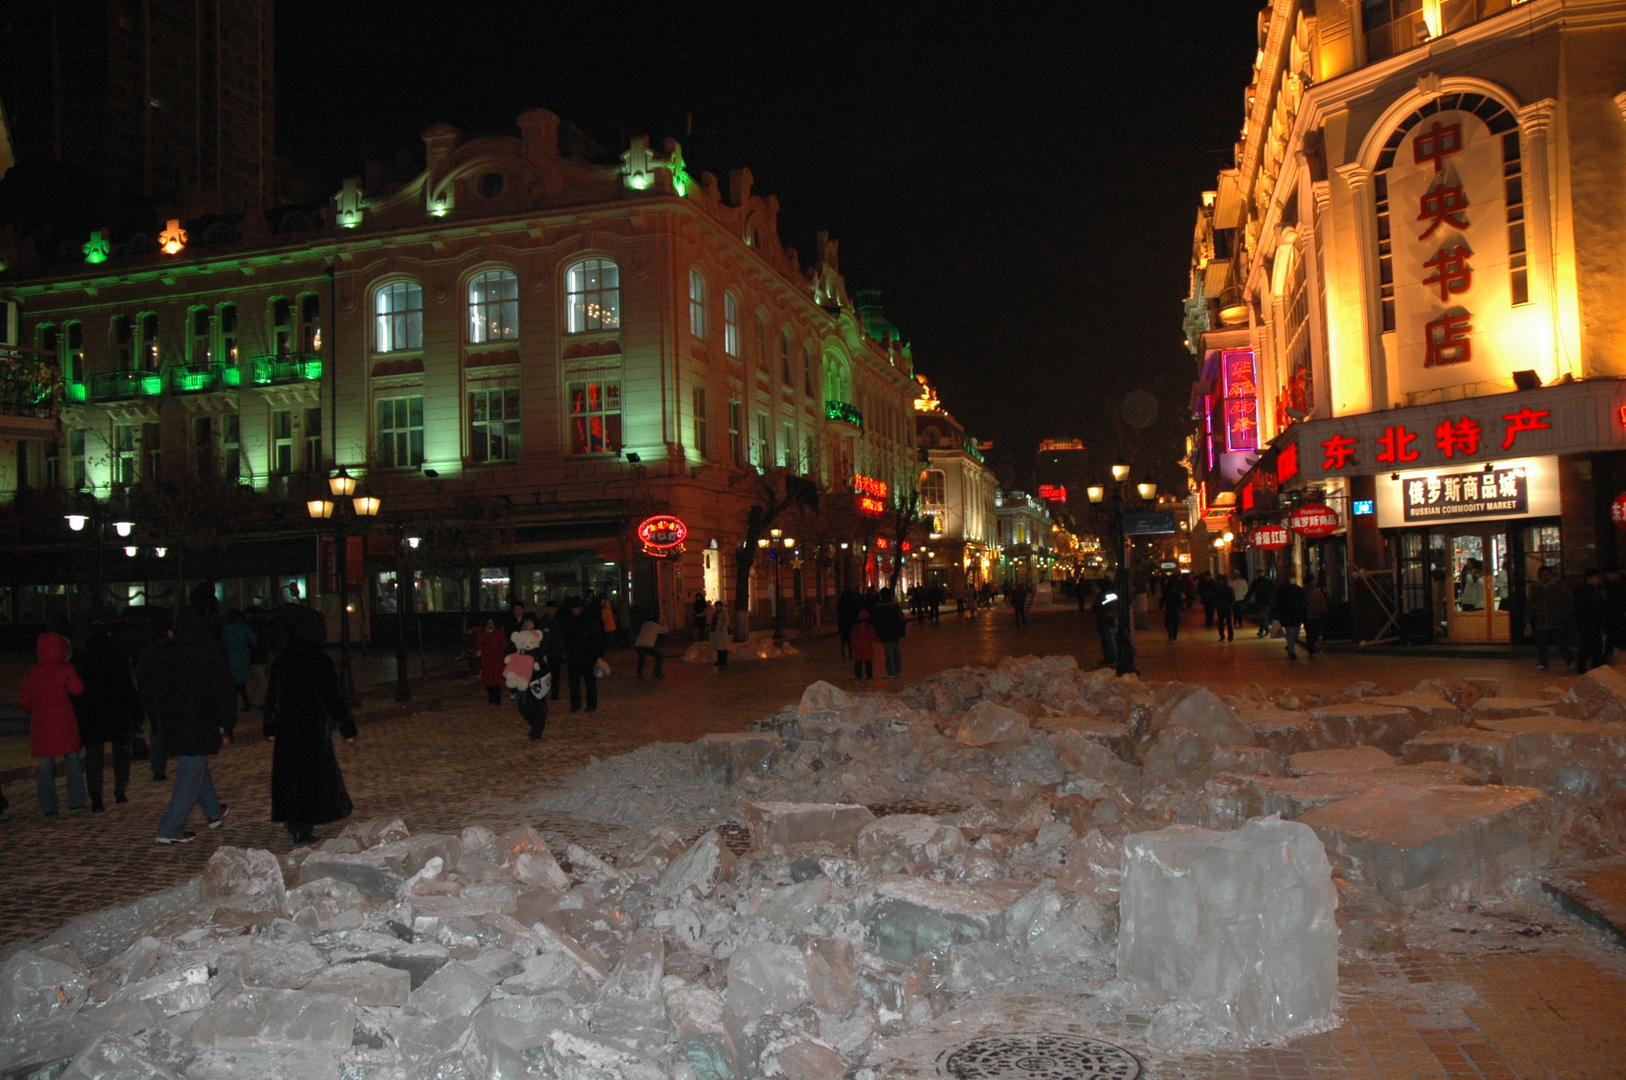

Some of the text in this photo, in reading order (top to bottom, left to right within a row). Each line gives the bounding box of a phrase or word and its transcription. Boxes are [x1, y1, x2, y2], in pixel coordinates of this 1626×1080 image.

[1413, 121, 1474, 368] 中央书店
[1321, 407, 1550, 470] 东北特产
[1409, 471, 1517, 505] 俄罗斯商品城
[1410, 500, 1517, 516] RUSSIAN COMMODITY MARKET
